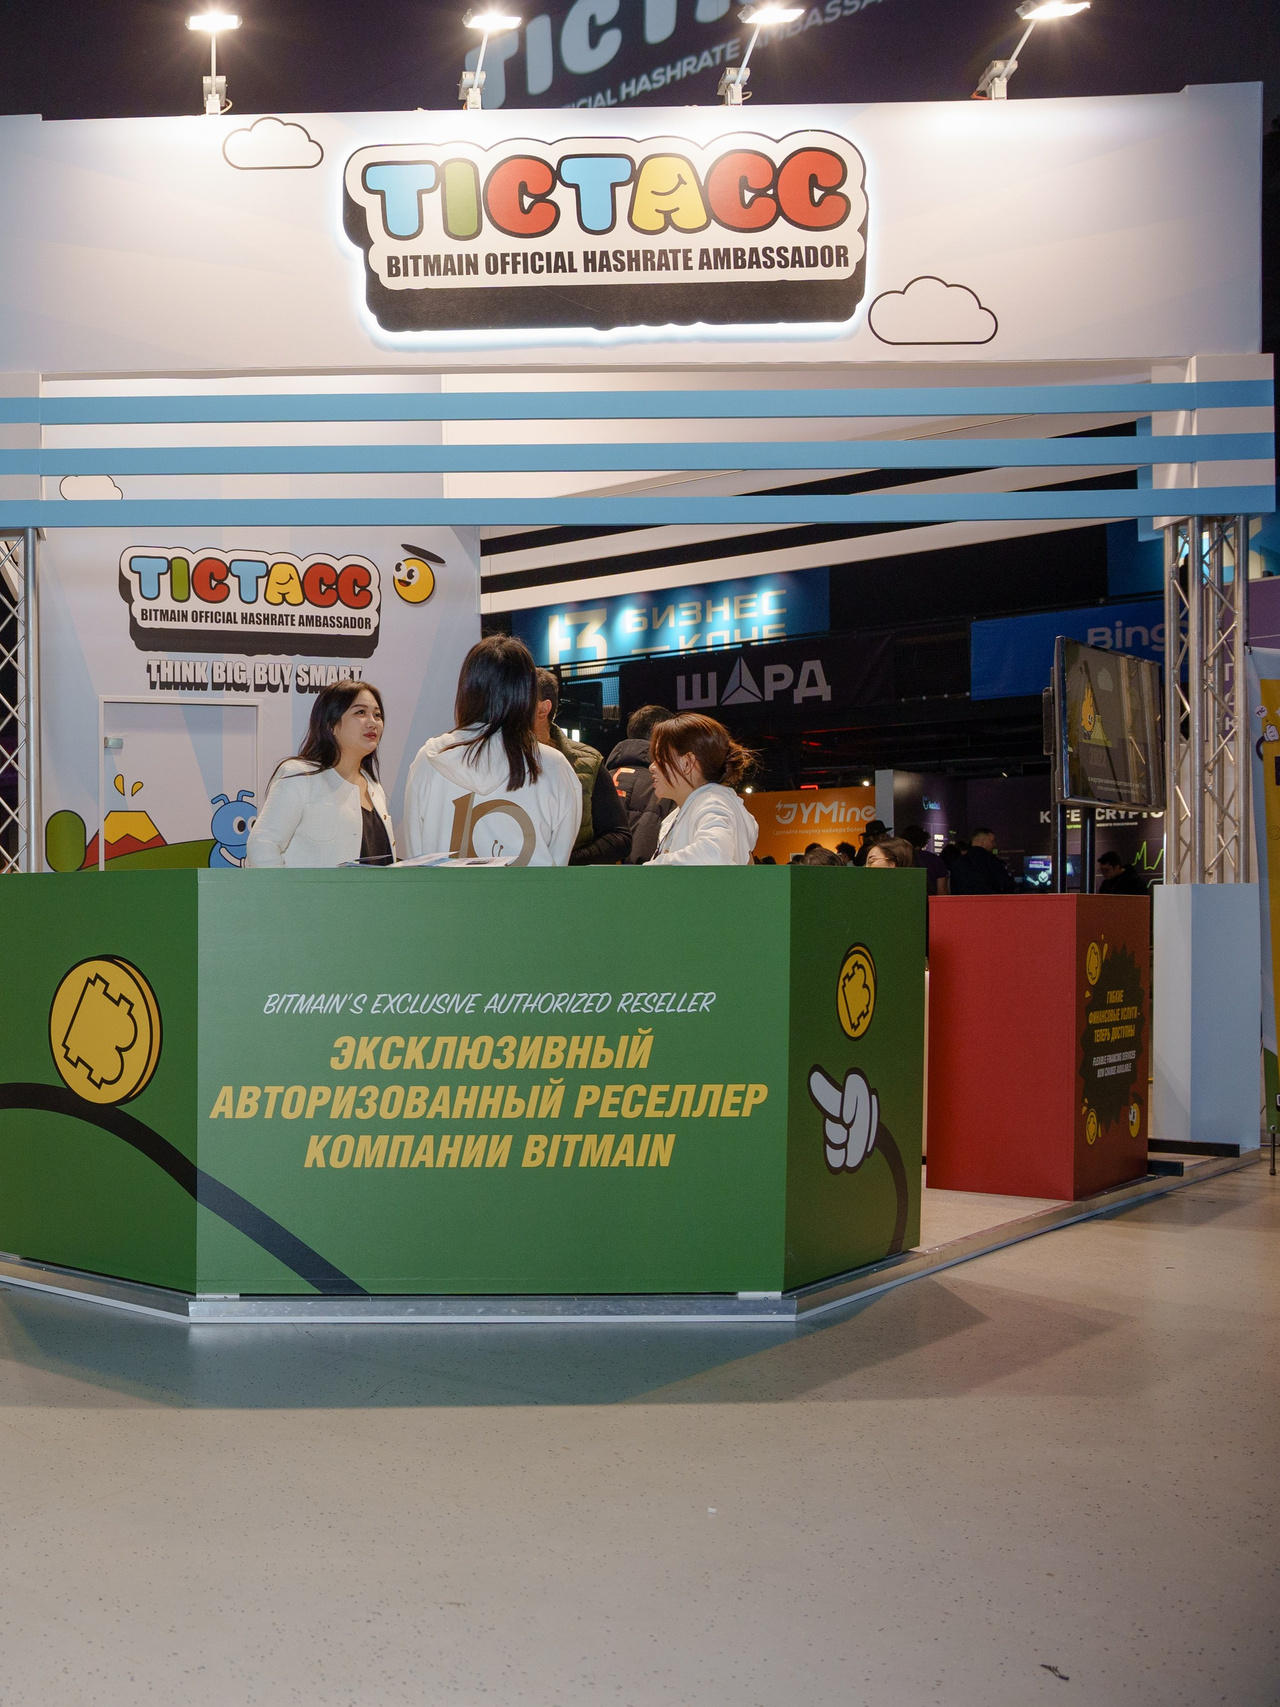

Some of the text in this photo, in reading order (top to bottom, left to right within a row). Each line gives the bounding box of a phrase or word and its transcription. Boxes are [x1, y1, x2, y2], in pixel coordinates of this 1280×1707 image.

[620, 38, 740, 101] HASHRATE
[361, 147, 852, 241] TICTACC
[386, 245, 850, 278] BITMAIN OFFICIAL HASHRATE AMBASSADOR
[129, 556, 373, 609] TICTACC
[140, 608, 372, 630] BITMAIN OFFICIAL HASHRATE AMBASSADOR
[625, 590, 787, 633] БИЗНЕС
[147, 660, 209, 686] THINK
[212, 661, 252, 688] BIG,
[253, 663, 293, 688] BUY
[262, 991, 717, 1015] BITMAIN'S EXCLUSIVE AUTHORIZED RESELLER
[329, 1028, 655, 1071] ЭКСКЛЮЗИВНЫЙ
[209, 1078, 769, 1120] АВТОРИЗОВАННЫЙ РЕСЕЛЛЕР
[303, 1133, 677, 1168] КОМПАНИИ BITMAIN
